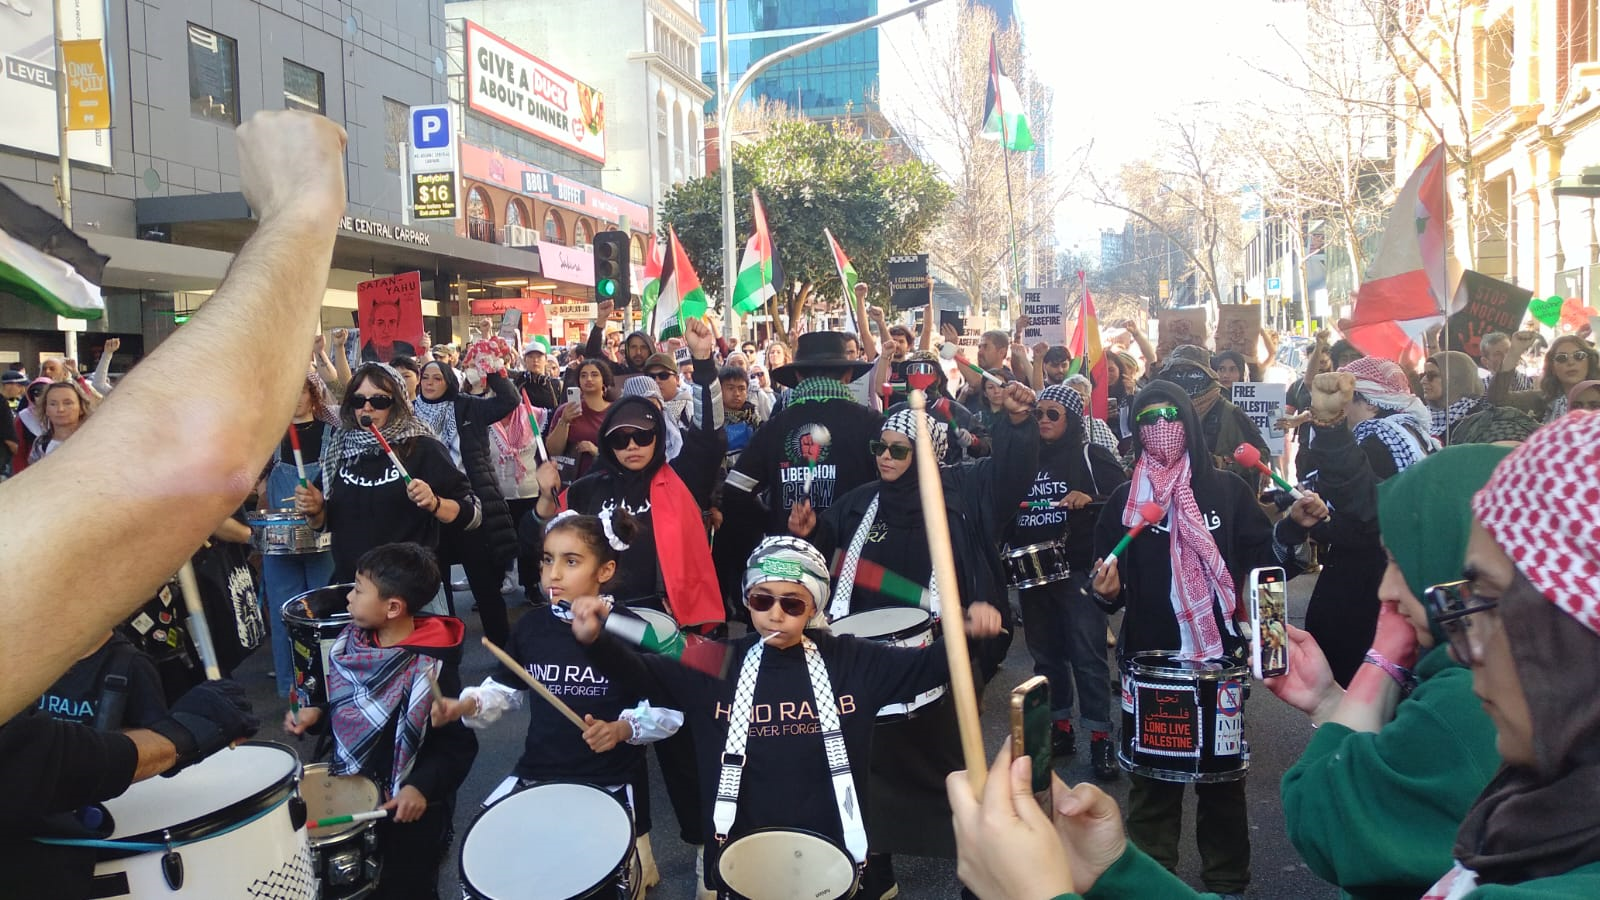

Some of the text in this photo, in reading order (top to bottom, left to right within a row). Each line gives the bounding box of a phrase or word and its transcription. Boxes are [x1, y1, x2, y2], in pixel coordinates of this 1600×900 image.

[9, 61, 53, 86] LEVEL
[477, 46, 568, 111] GIVE A DUCK
[479, 76, 524, 111] ABOUT
[527, 98, 569, 132] DINNER
[421, 115, 441, 142] P
[417, 173, 449, 184] Earlybird
[525, 172, 543, 193] BBQ
[419, 185, 448, 203] $16
[558, 182, 581, 205] BUFFET
[355, 218, 392, 239] CENTRAL
[394, 226, 430, 246] CARPARK
[385, 281, 416, 295] YAHU
[1025, 292, 1040, 302] FREE
[1025, 304, 1062, 315] PALESTINE,
[1029, 316, 1060, 326] EASEFIRE
[1234, 386, 1256, 397] FREE
[564, 685, 609, 696] FORGET
[1145, 705, 1190, 721] فلسطين
[748, 722, 821, 737] EVER FORGE
[1144, 720, 1191, 735] LONG LIVE
[1143, 733, 1193, 749] PALESTINE
